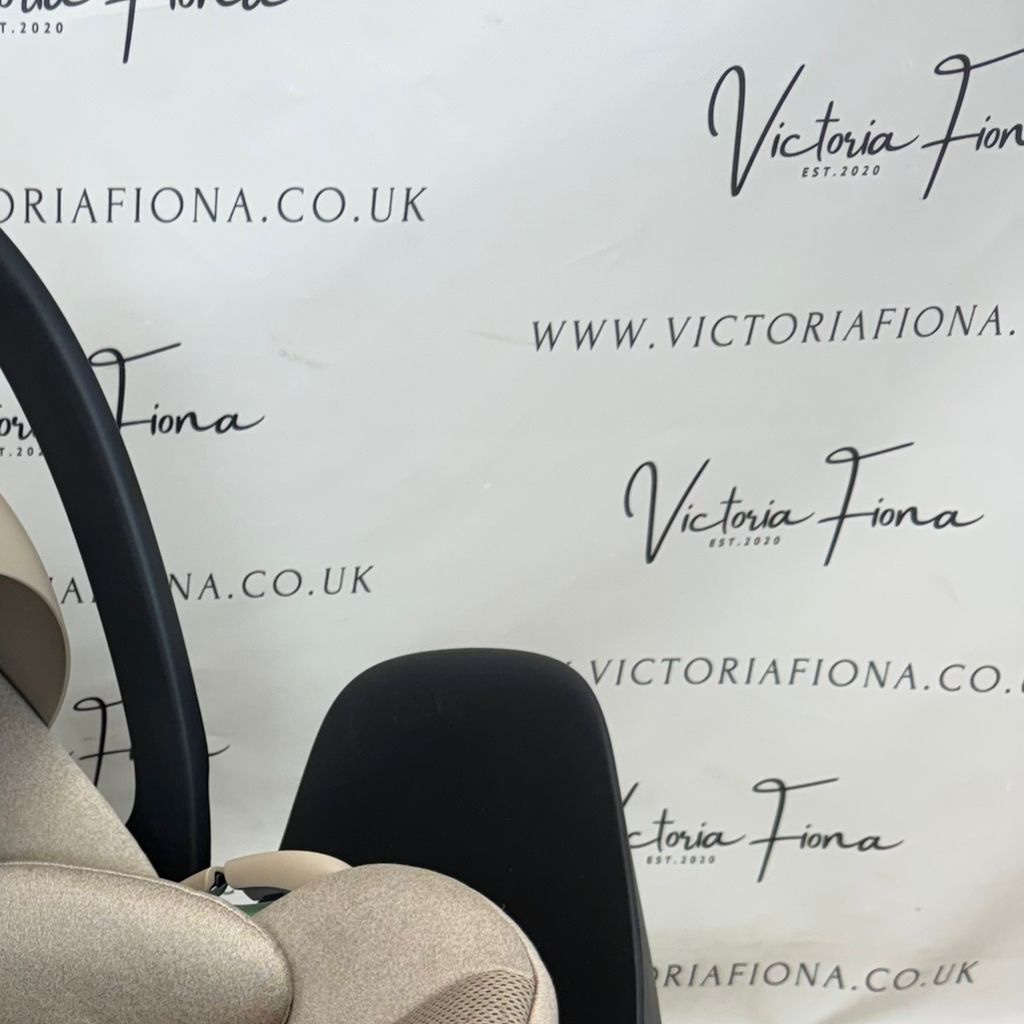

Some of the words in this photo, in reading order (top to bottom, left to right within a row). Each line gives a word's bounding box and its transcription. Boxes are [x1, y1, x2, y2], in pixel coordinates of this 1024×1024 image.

[707, 65, 920, 198] Victoria
[801, 164, 881, 179] EST.2020
[624, 459, 815, 564] Victoria
[818, 442, 985, 567] Fiona
[709, 536, 781, 548] EST.2020
[646, 855, 716, 865] EST.2020
[749, 778, 904, 883] Fiona
